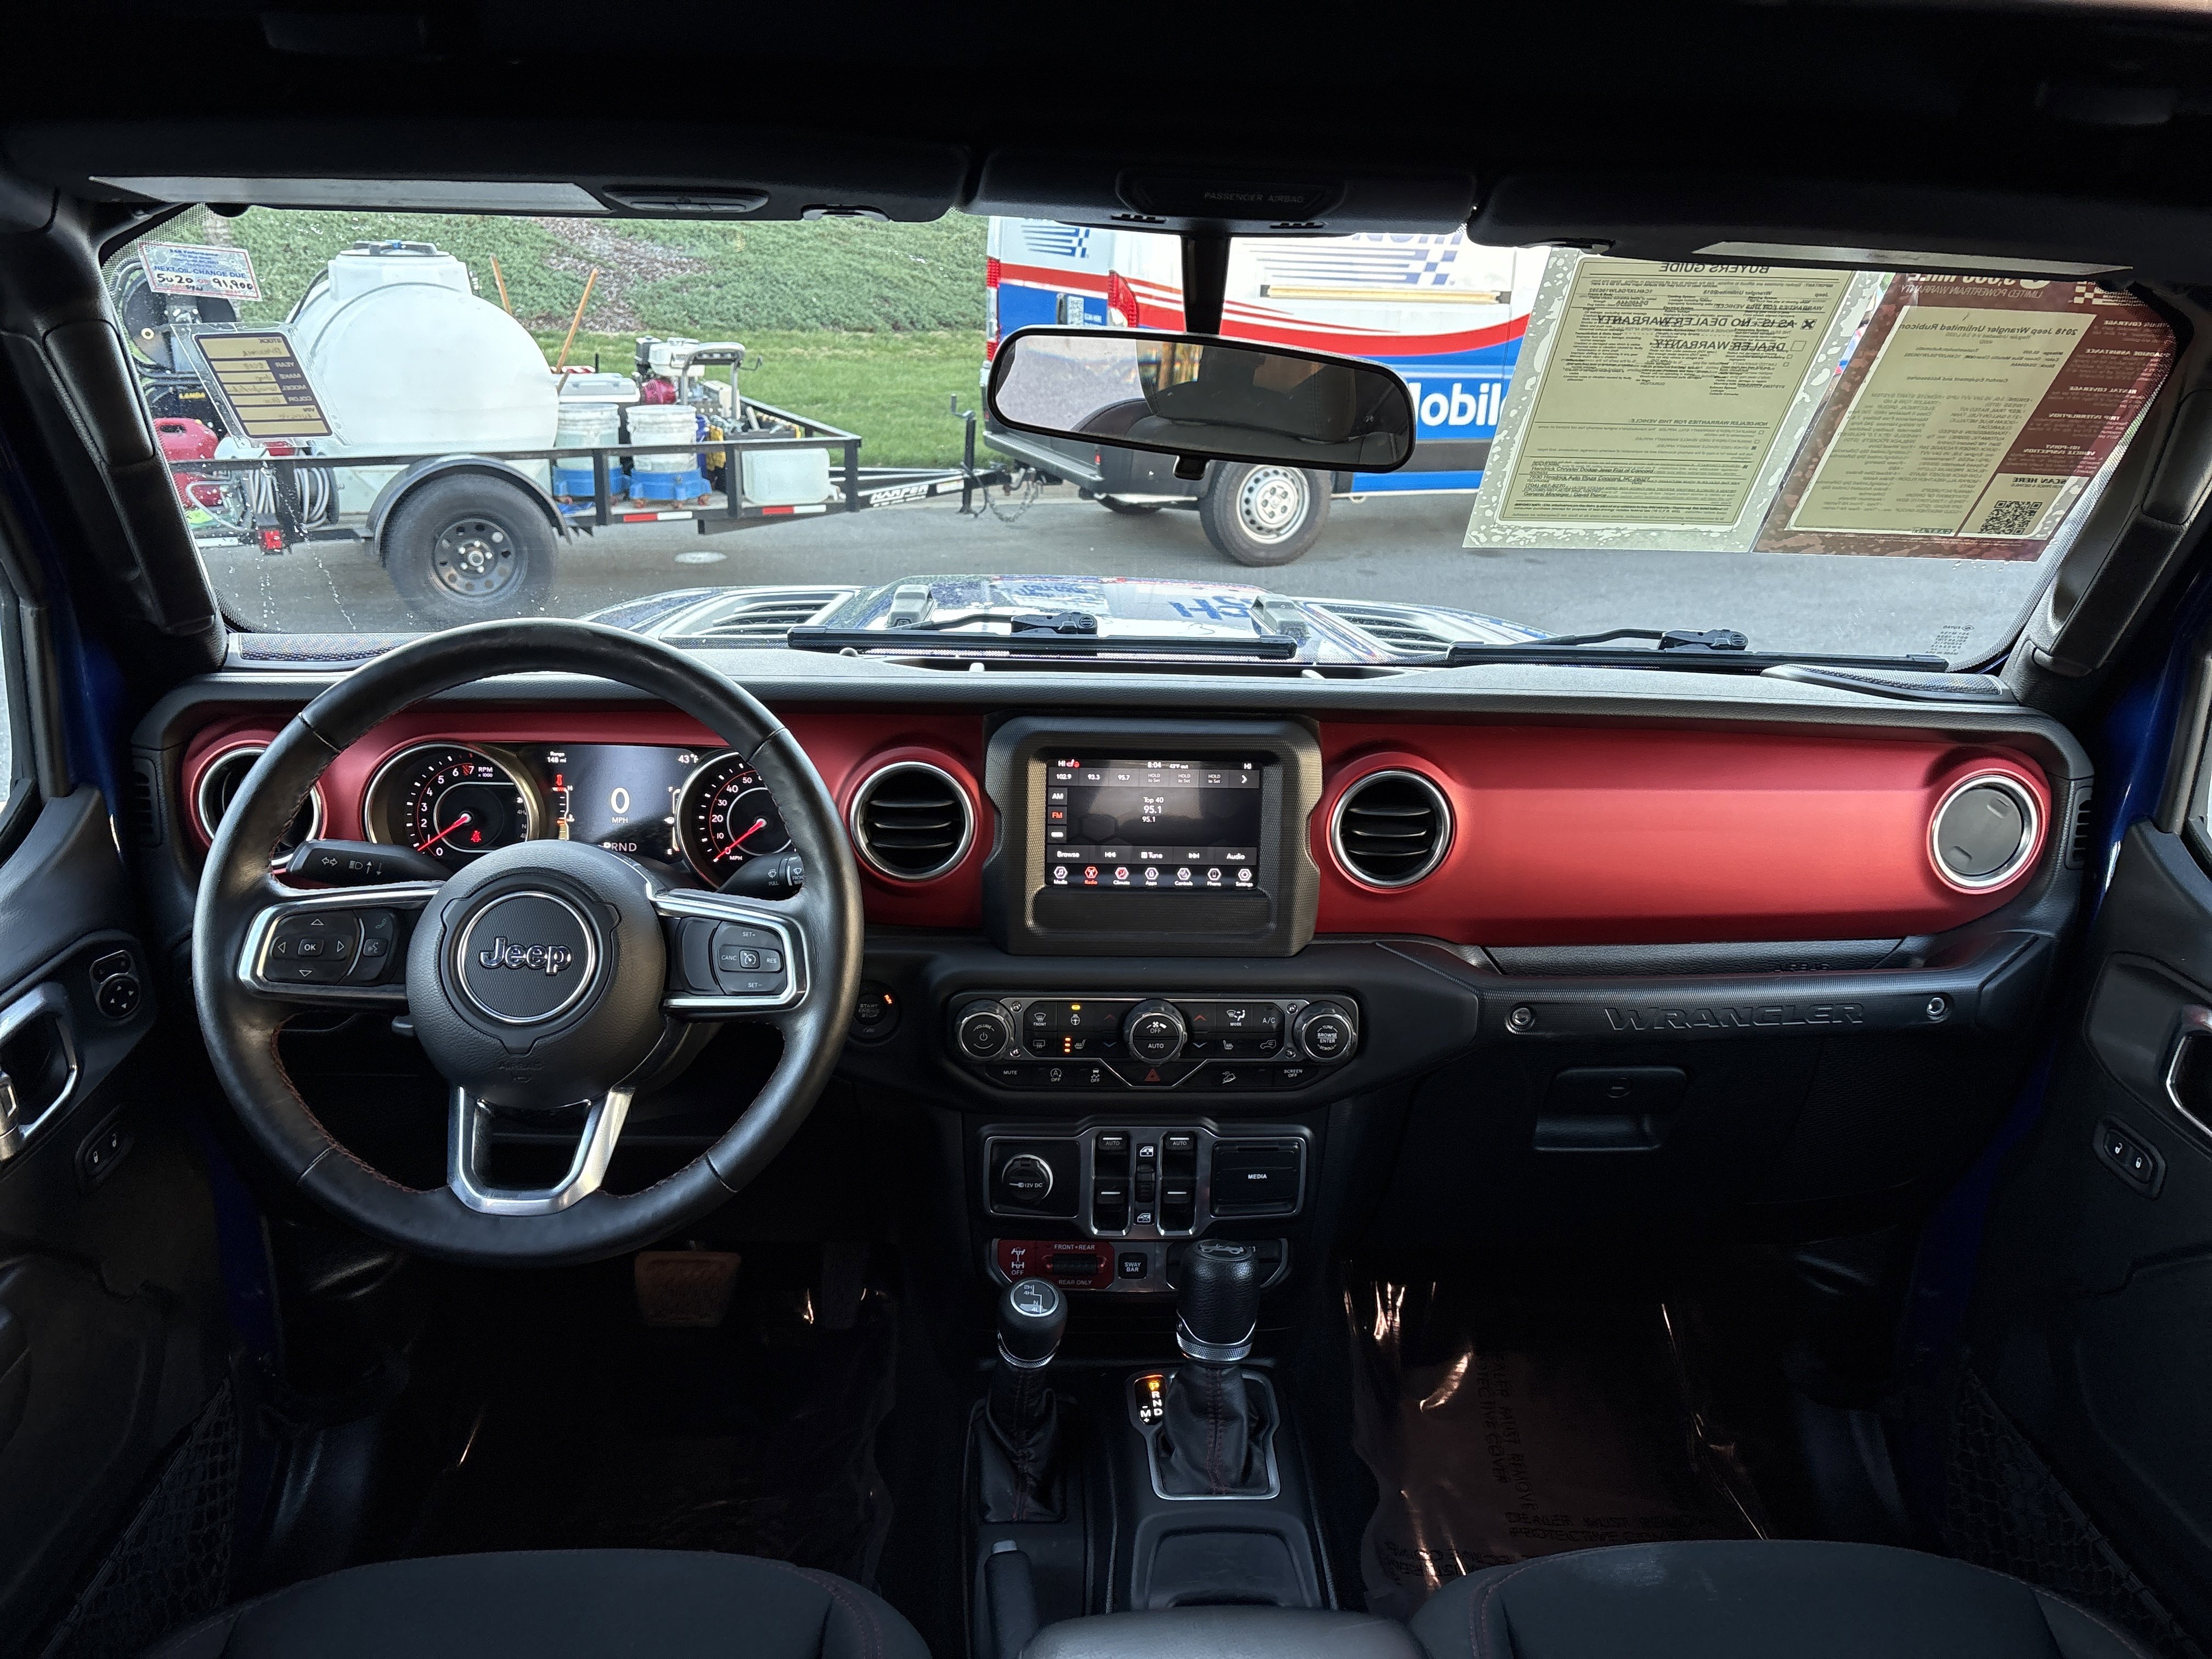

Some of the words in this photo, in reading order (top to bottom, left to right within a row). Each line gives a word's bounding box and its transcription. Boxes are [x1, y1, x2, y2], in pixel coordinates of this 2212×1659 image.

[1408, 382, 1508, 426] obil
[452, 768, 459, 776] 6
[426, 788, 433, 797] 4
[726, 785, 738, 793] 40
[611, 787, 630, 814] 0
[421, 803, 427, 811] 3
[1143, 805, 1162, 814] 95.1
[712, 814, 724, 822] 20
[421, 819, 427, 827] 2
[436, 848, 443, 856] 0
[304, 944, 317, 952] OK
[479, 936, 572, 975] Jeep
[1604, 1003, 1864, 1032] WRANGLER
[1153, 1399, 1162, 1407] N
